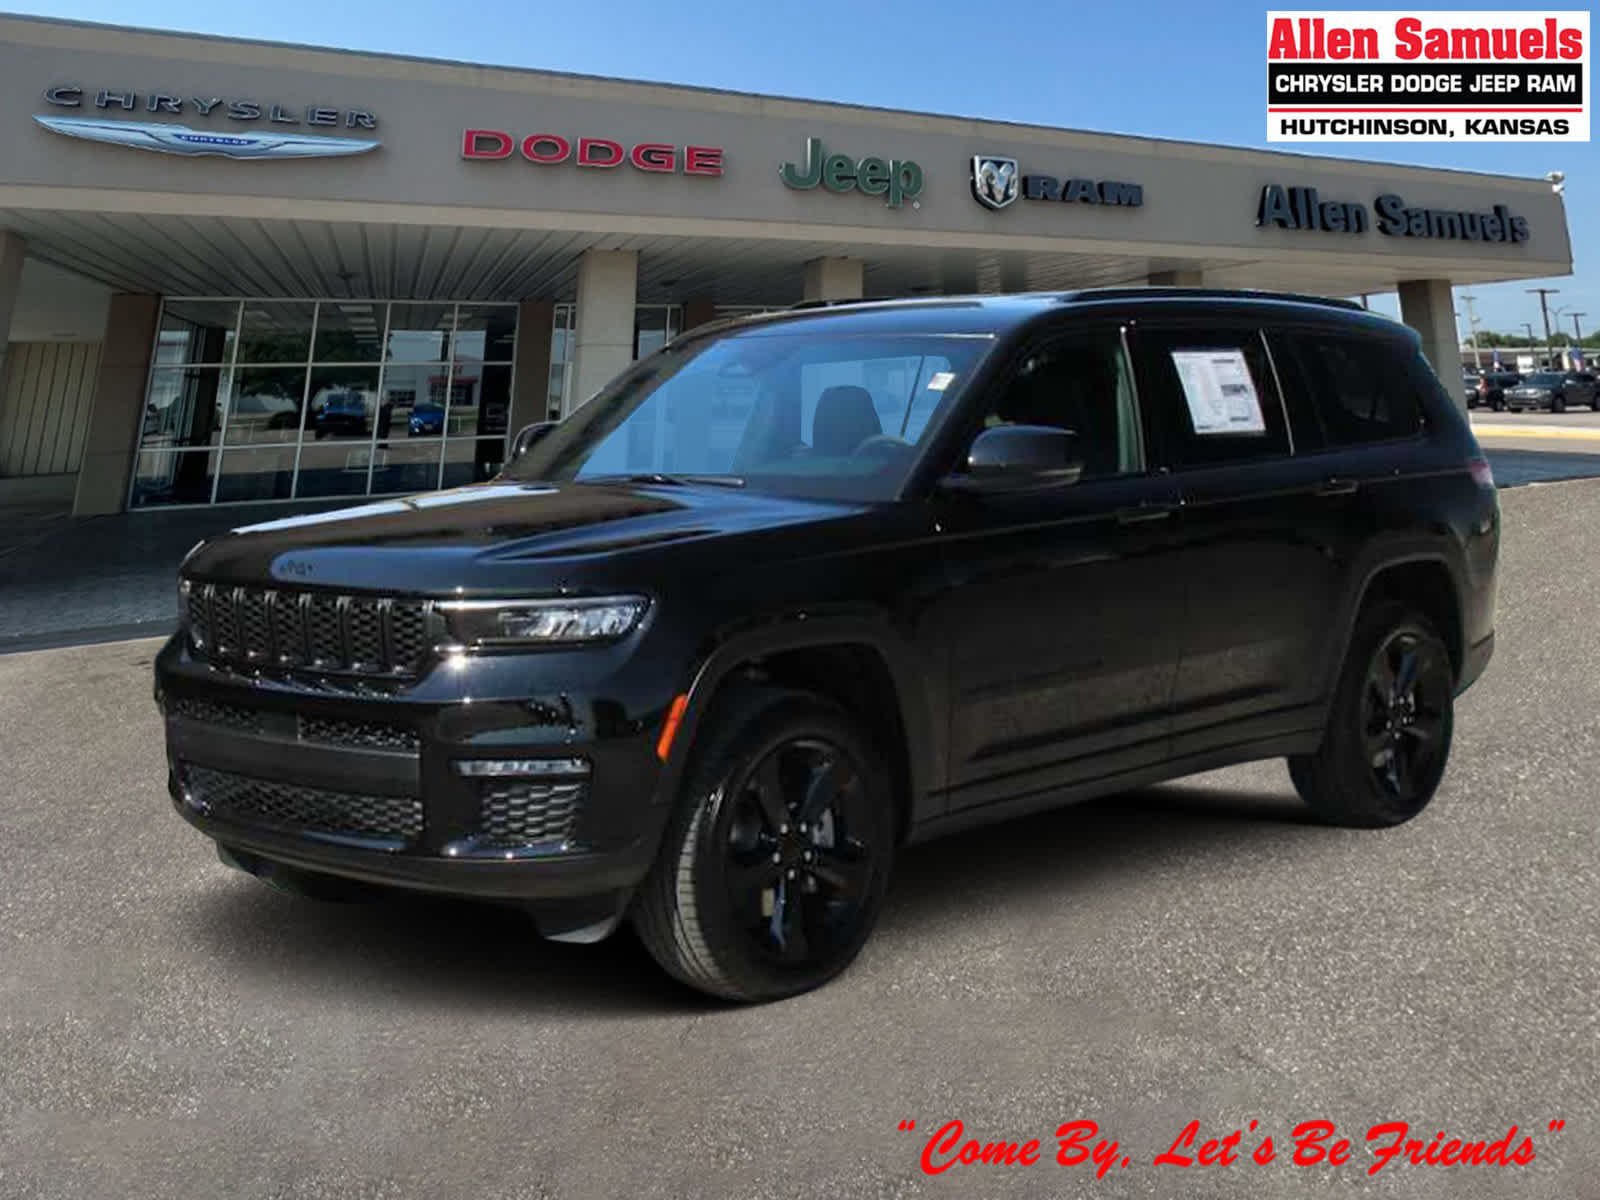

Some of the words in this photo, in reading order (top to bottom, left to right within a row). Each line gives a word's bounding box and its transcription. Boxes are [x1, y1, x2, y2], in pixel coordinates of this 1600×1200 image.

[43, 86, 378, 129] CHRYSLER
[461, 128, 724, 176] DODGE
[779, 136, 924, 209] Jeep
[1022, 174, 1143, 207] RAM
[1257, 183, 1367, 233] Allen
[1374, 193, 1531, 244] Samuels
